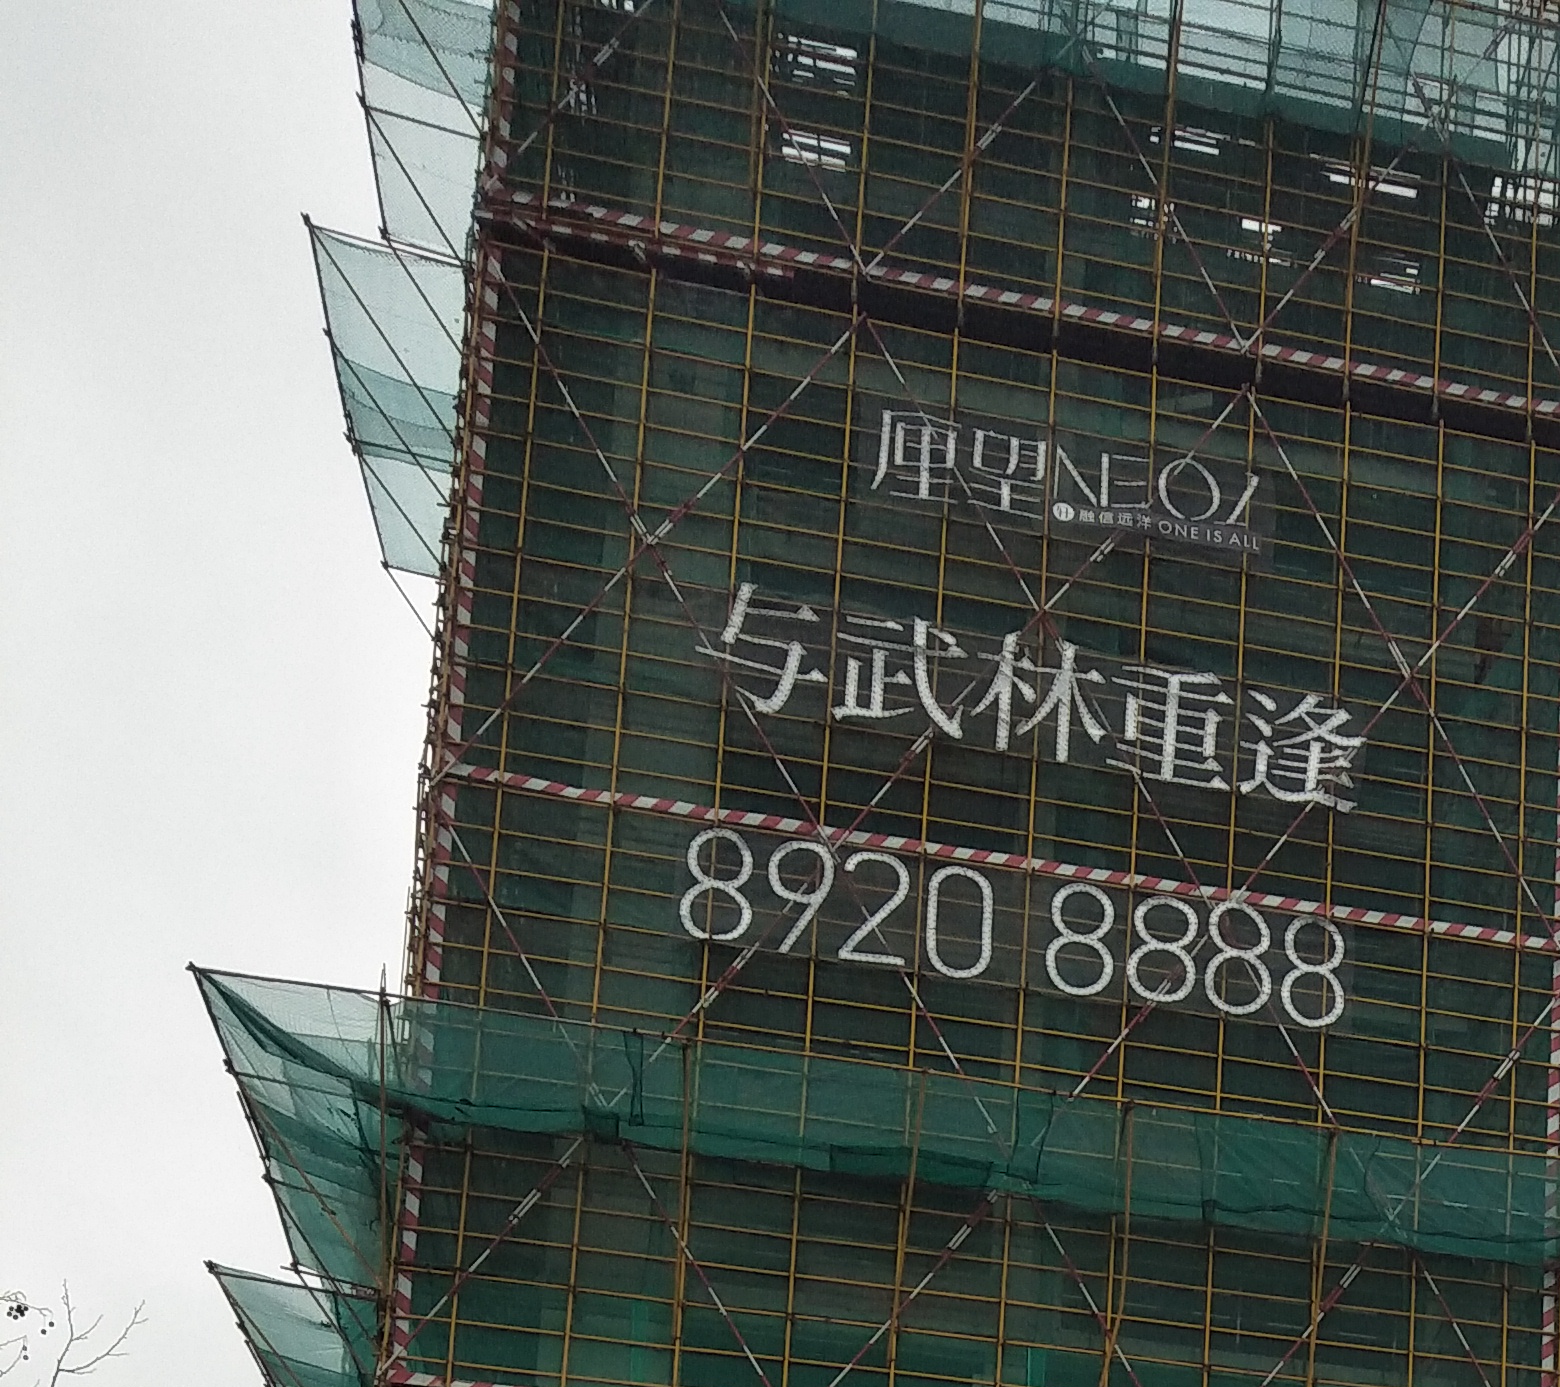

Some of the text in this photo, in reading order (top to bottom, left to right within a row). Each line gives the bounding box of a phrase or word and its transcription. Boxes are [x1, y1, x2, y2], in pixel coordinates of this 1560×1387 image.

[1078, 508, 1260, 551] 融信远洋 ONE IS ALL
[695, 583, 1366, 813] 与武林重逢
[679, 828, 1346, 1027] 8920 8888
